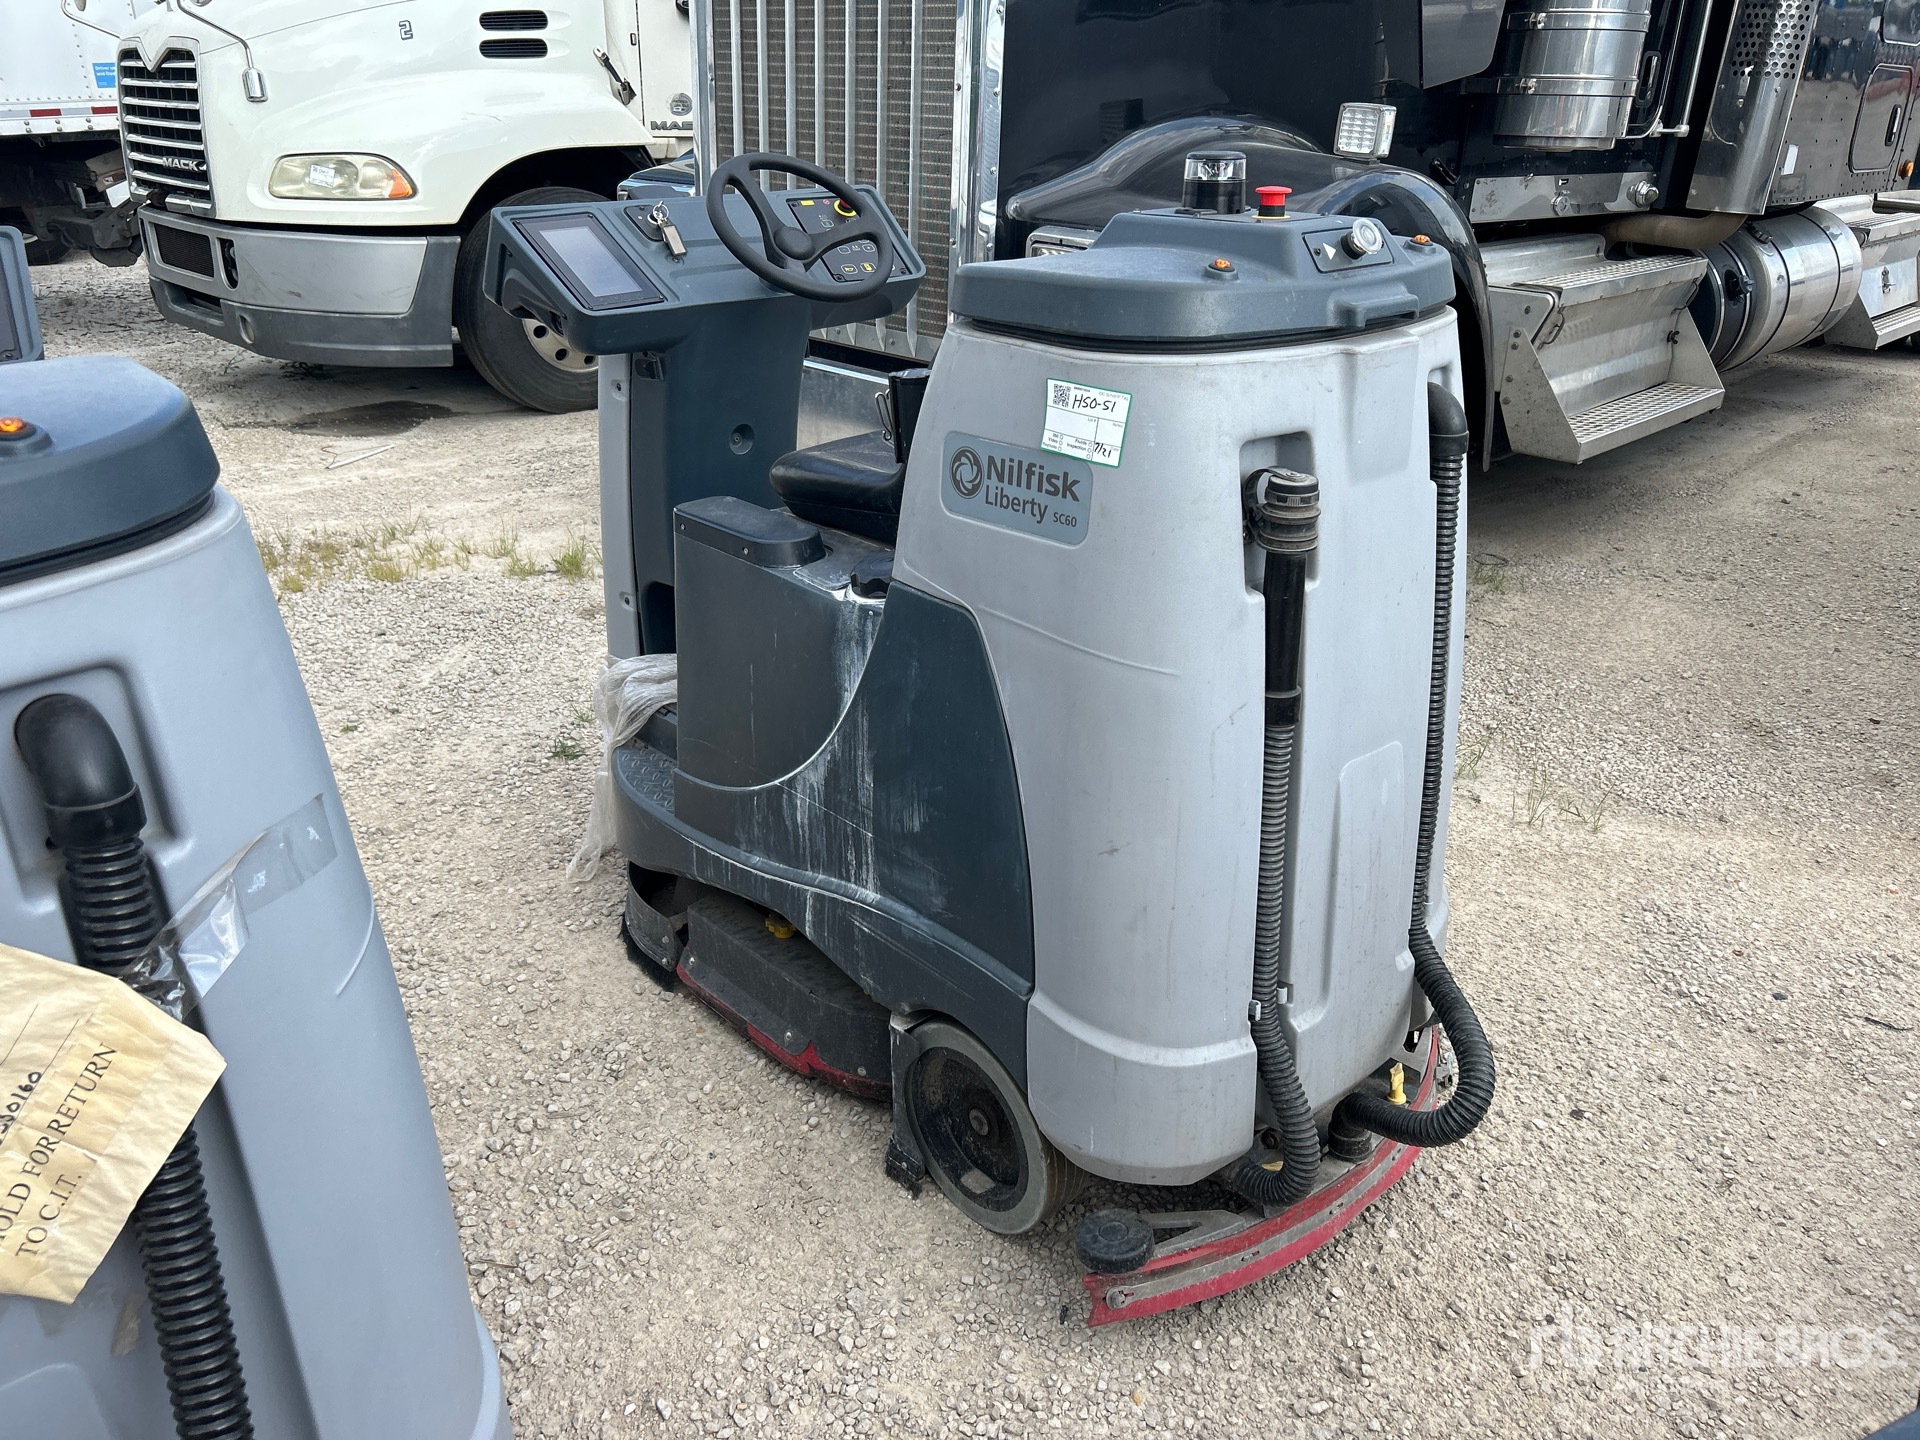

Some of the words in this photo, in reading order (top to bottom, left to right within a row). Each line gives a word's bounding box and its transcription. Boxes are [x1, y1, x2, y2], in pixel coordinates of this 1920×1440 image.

[399, 19, 413, 40] 2
[162, 157, 198, 171] MACK
[986, 455, 1081, 502] Nilfisk
[985, 484, 1049, 524] Liberty
[1053, 511, 1077, 528] SC60
[0, 1182, 32, 1247] OLD
[20, 1136, 60, 1178] FOR
[47, 1041, 118, 1136] RETURN
[15, 1226, 48, 1257] TO
[39, 1174, 82, 1221] C.I.T.
